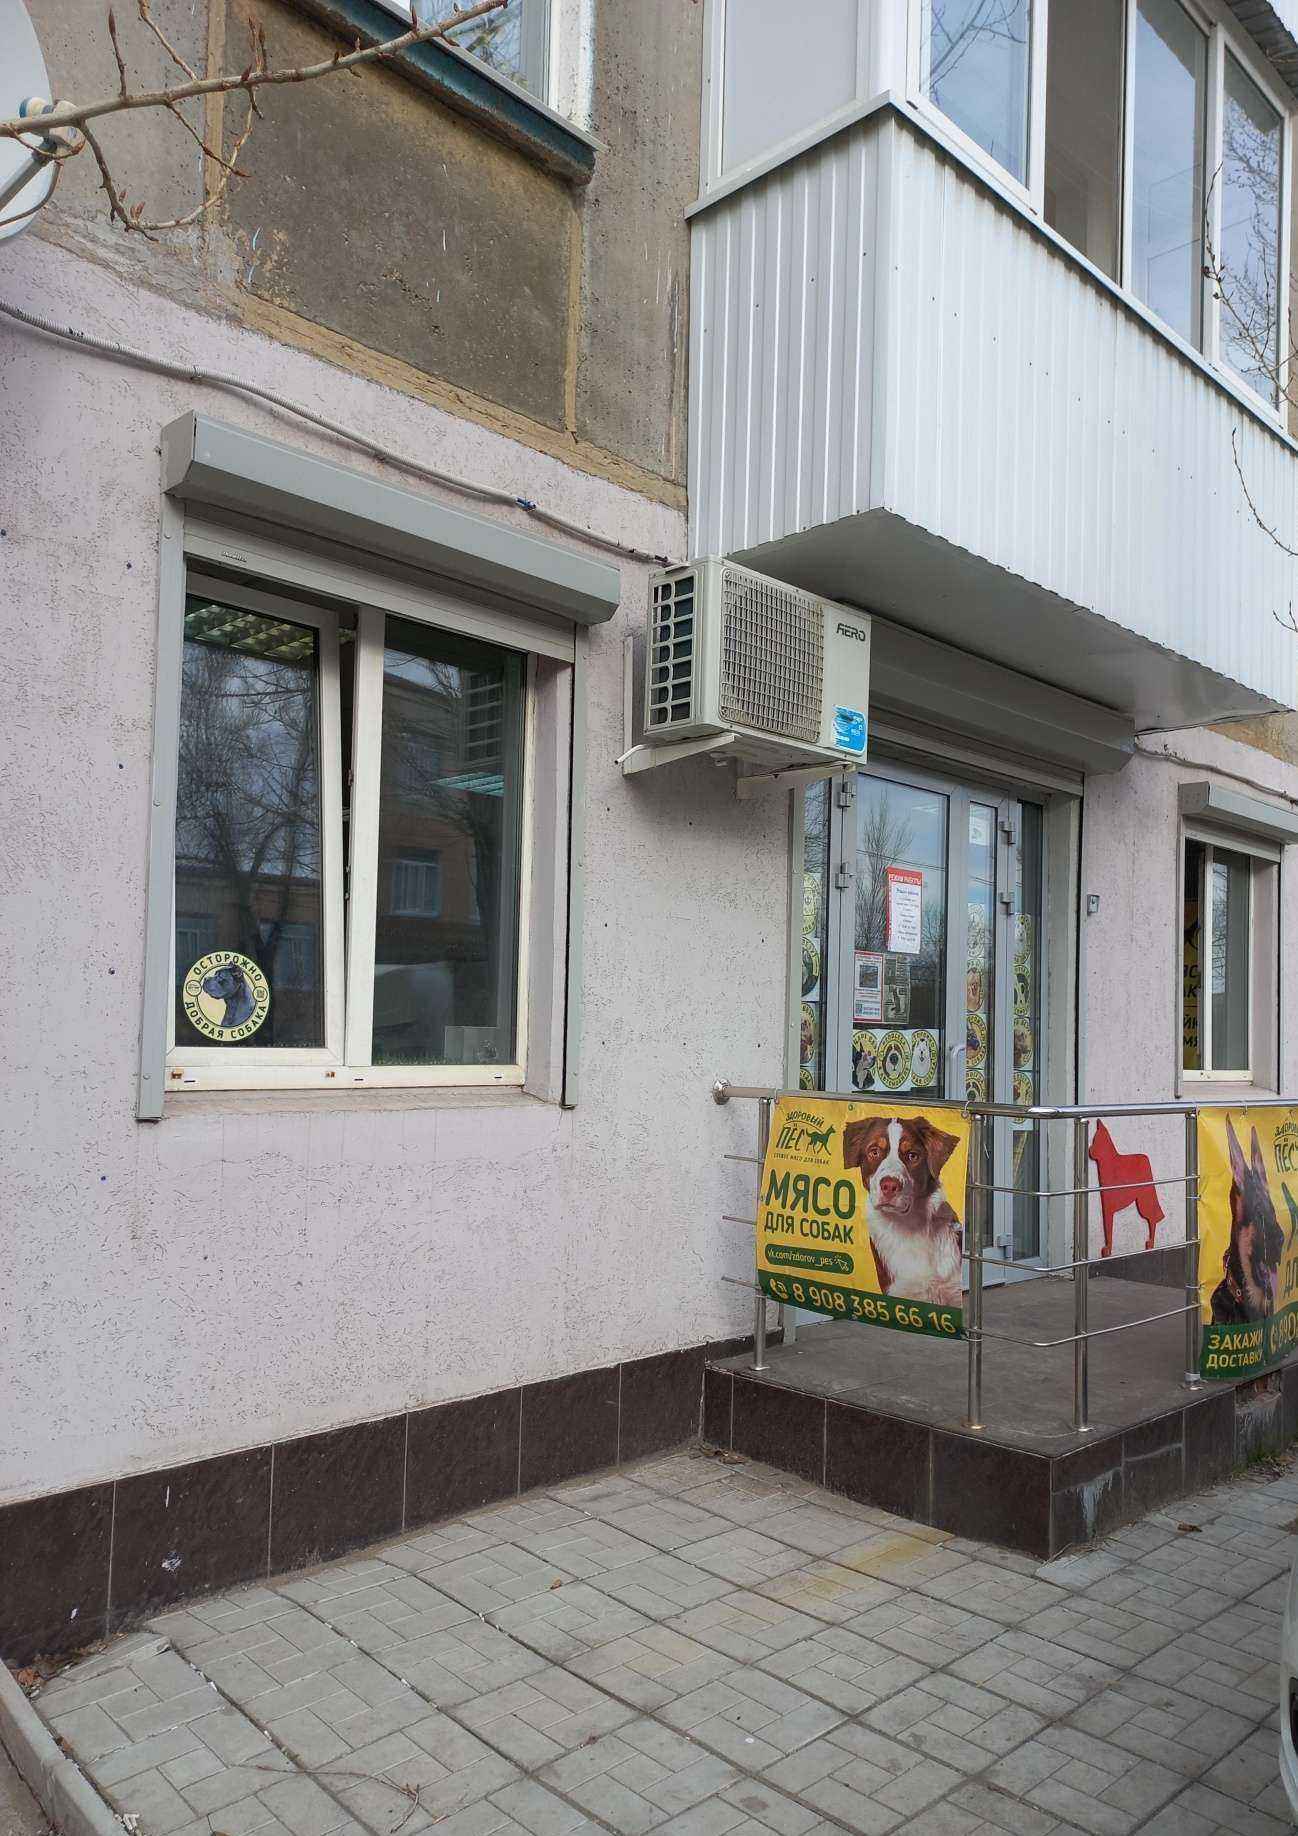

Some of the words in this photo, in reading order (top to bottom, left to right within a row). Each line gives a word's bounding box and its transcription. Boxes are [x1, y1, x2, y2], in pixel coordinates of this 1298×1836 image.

[193, 953, 263, 982] ОСТОРОЖНО
[185, 1001, 225, 1039] ДОБРАЯ
[230, 1004, 267, 1039] СОБАКА
[785, 1110, 825, 1128] ЗДОРОВЫЙ
[765, 1168, 857, 1220] МЯСО
[764, 1211, 795, 1235] ДЛЯ
[800, 1217, 854, 1245] СОБАК
[792, 1283, 805, 1303] 8
[809, 1286, 846, 1312] 908
[851, 1295, 890, 1321] 385
[895, 1304, 924, 1328] 66
[928, 1311, 957, 1334] 16
[1208, 1328, 1264, 1351] ЗАКАЖИ
[1206, 1350, 1264, 1370] ДОСТАВКУ
